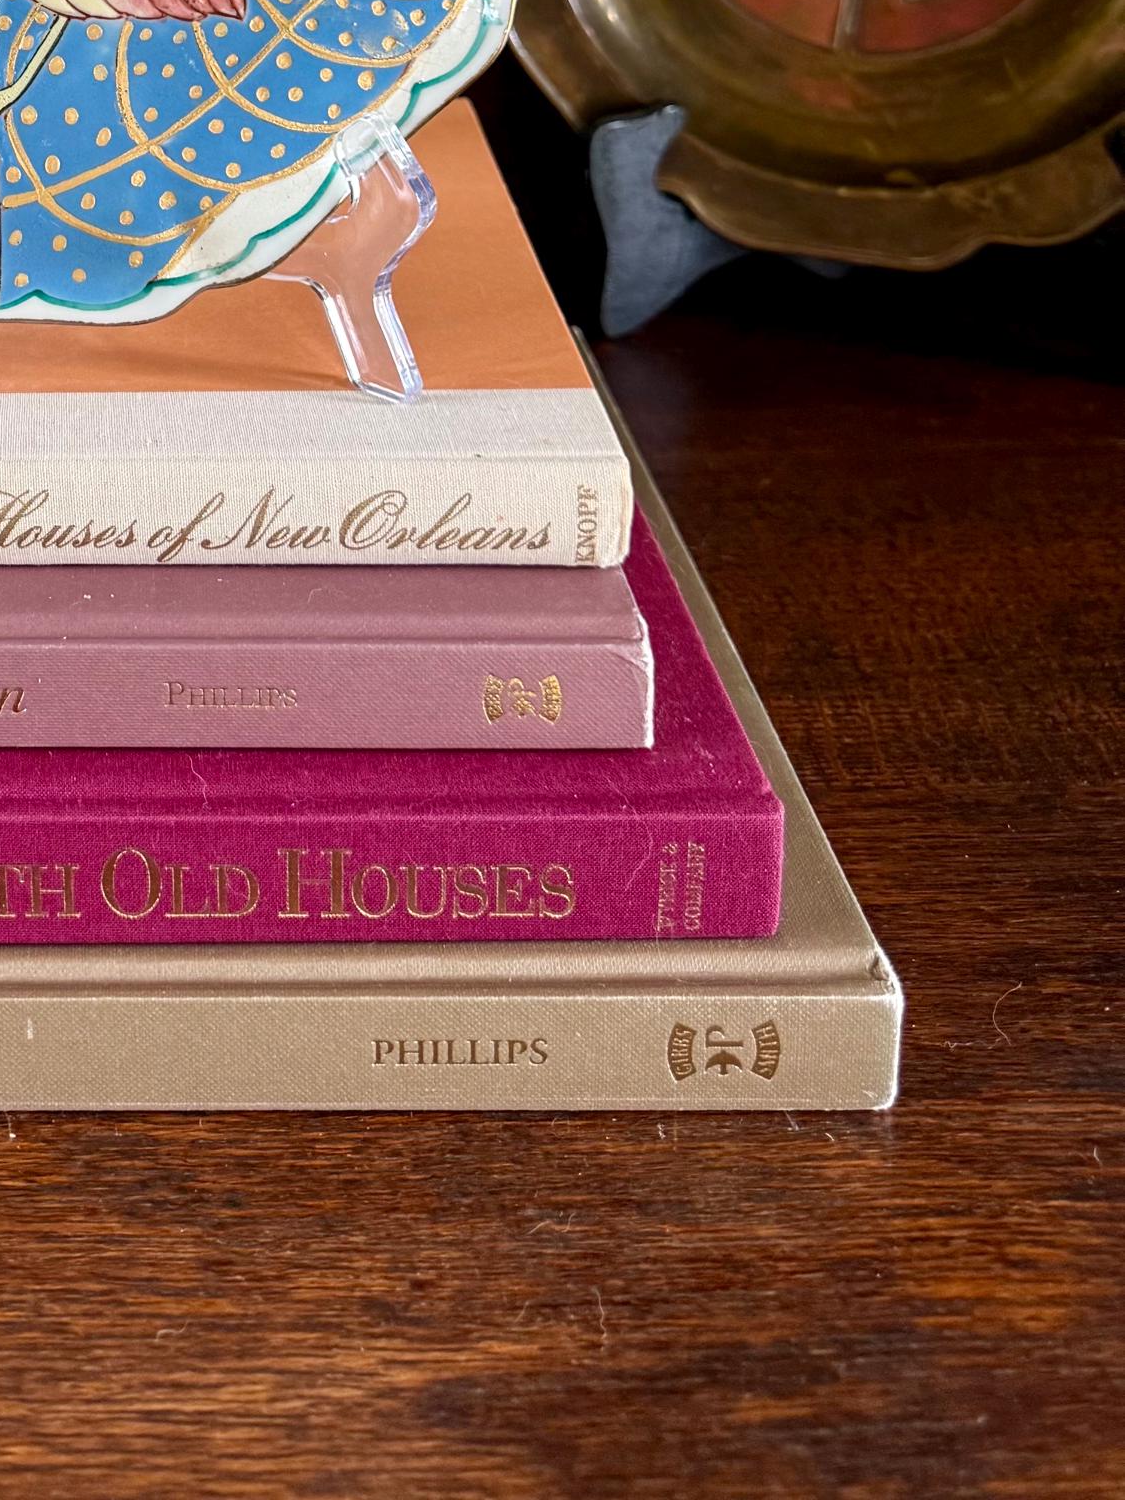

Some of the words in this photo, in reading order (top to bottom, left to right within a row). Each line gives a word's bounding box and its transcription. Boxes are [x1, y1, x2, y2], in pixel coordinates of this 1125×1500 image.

[146, 491, 226, 563] of
[200, 488, 333, 550] New
[337, 490, 553, 550] Orleans
[575, 484, 598, 563] KNOPF
[162, 680, 299, 709] PHILLIPS
[100, 846, 261, 920] OLD
[276, 847, 577, 919] HOUSES
[371, 1037, 549, 1066] PHILLIPS
[671, 1028, 694, 1076] GIBBS
[755, 1025, 779, 1074] SMITH
